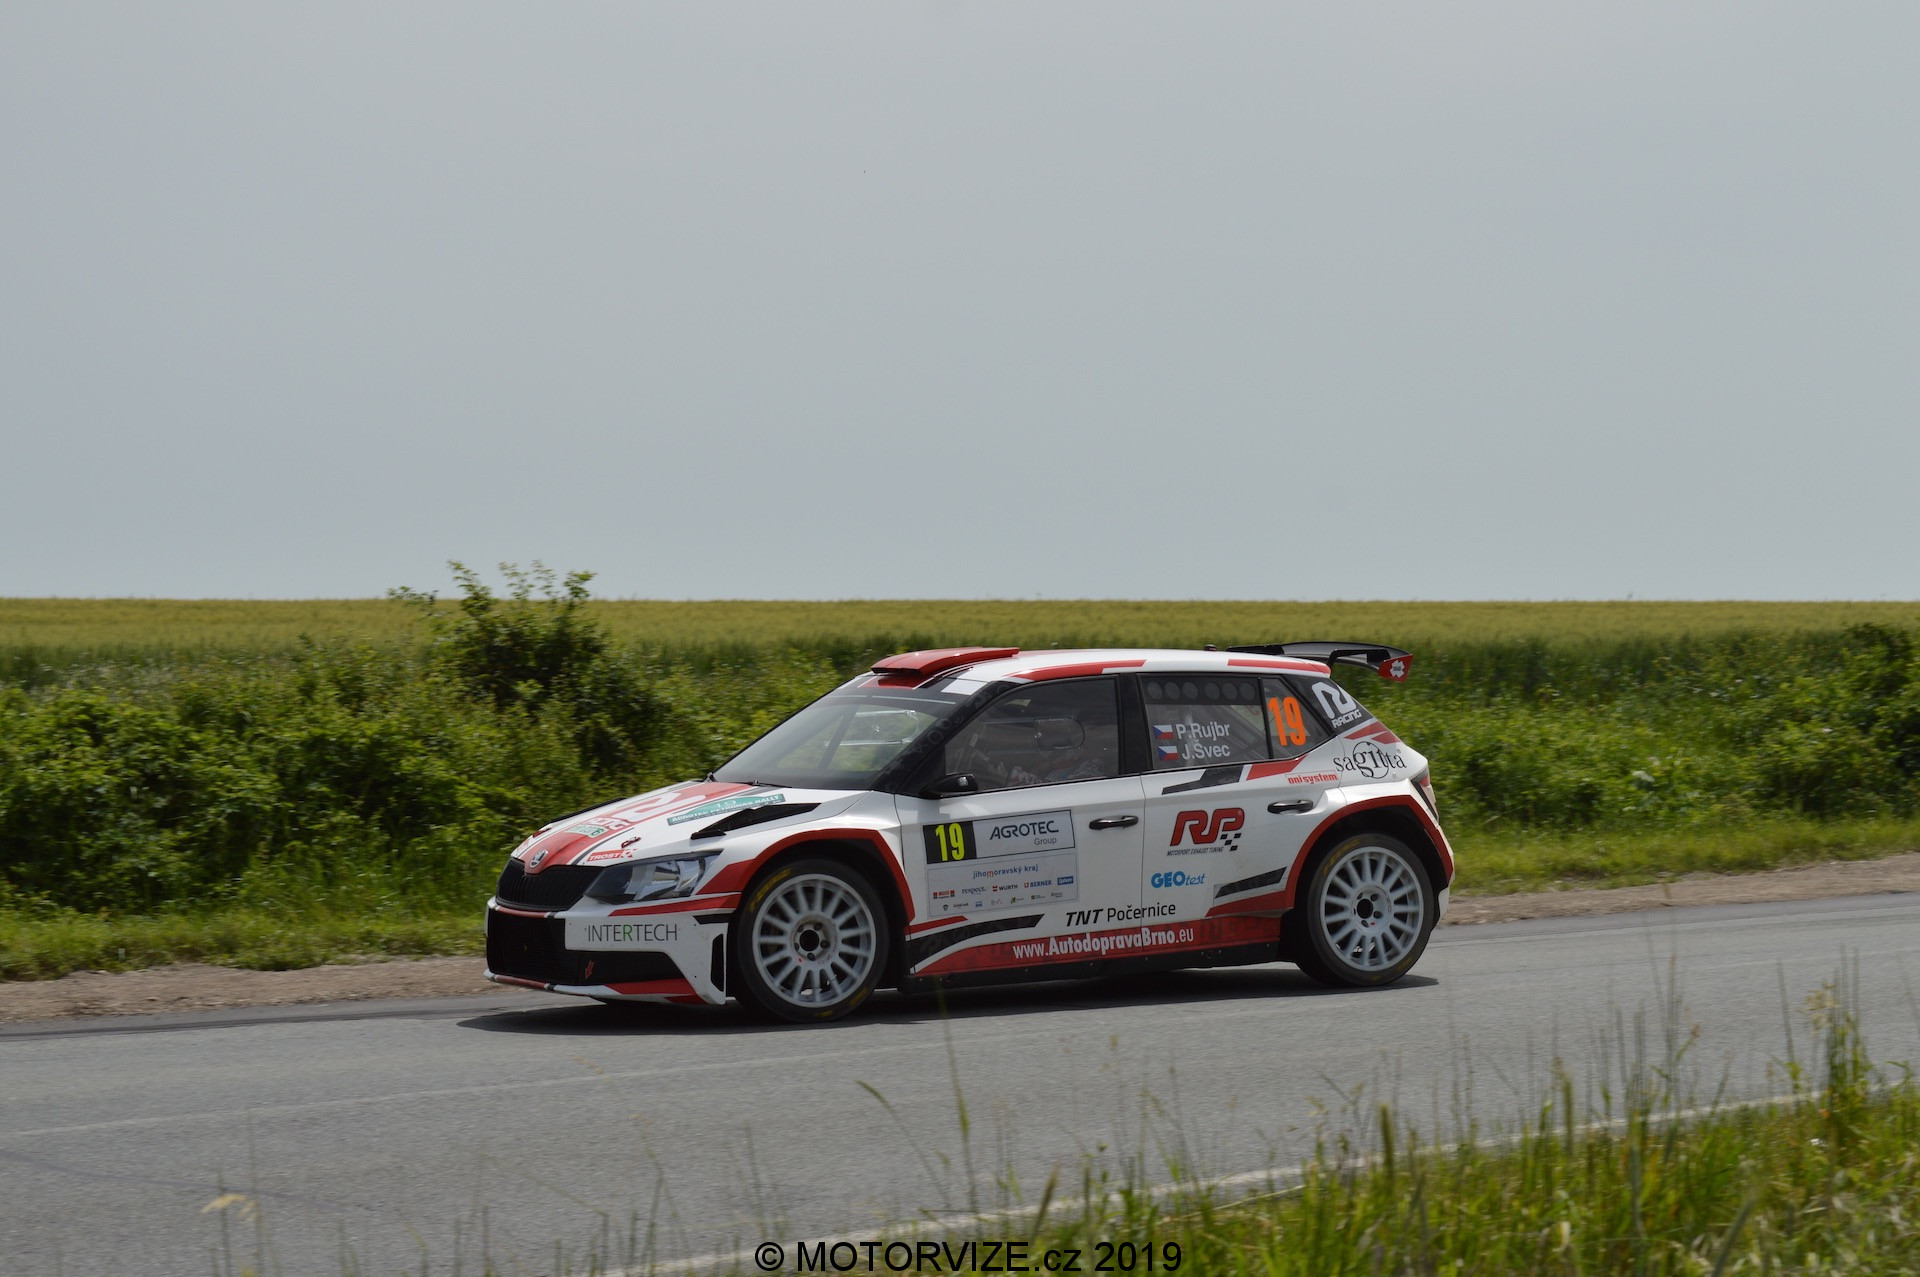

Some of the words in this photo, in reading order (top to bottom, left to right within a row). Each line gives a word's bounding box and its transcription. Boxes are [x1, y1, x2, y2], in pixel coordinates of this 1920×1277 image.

[1267, 696, 1307, 747] 19
[1331, 709, 1362, 728] RACING
[1176, 721, 1230, 741] P.Rujbr
[1182, 738, 1231, 760] J.Švec
[1333, 746, 1407, 778] sagitta
[989, 820, 1060, 841] AGROTEC
[935, 822, 965, 862] 19
[1034, 836, 1058, 846] Group
[588, 852, 621, 861] TROST
[1024, 864, 1039, 872] kraj
[1029, 879, 1052, 888] BERNER
[1066, 909, 1104, 927] TNT
[1107, 902, 1176, 923] Počernice
[587, 923, 678, 943] INTERTECH
[1012, 927, 1195, 959] www.AutodopravaBrno.eu
